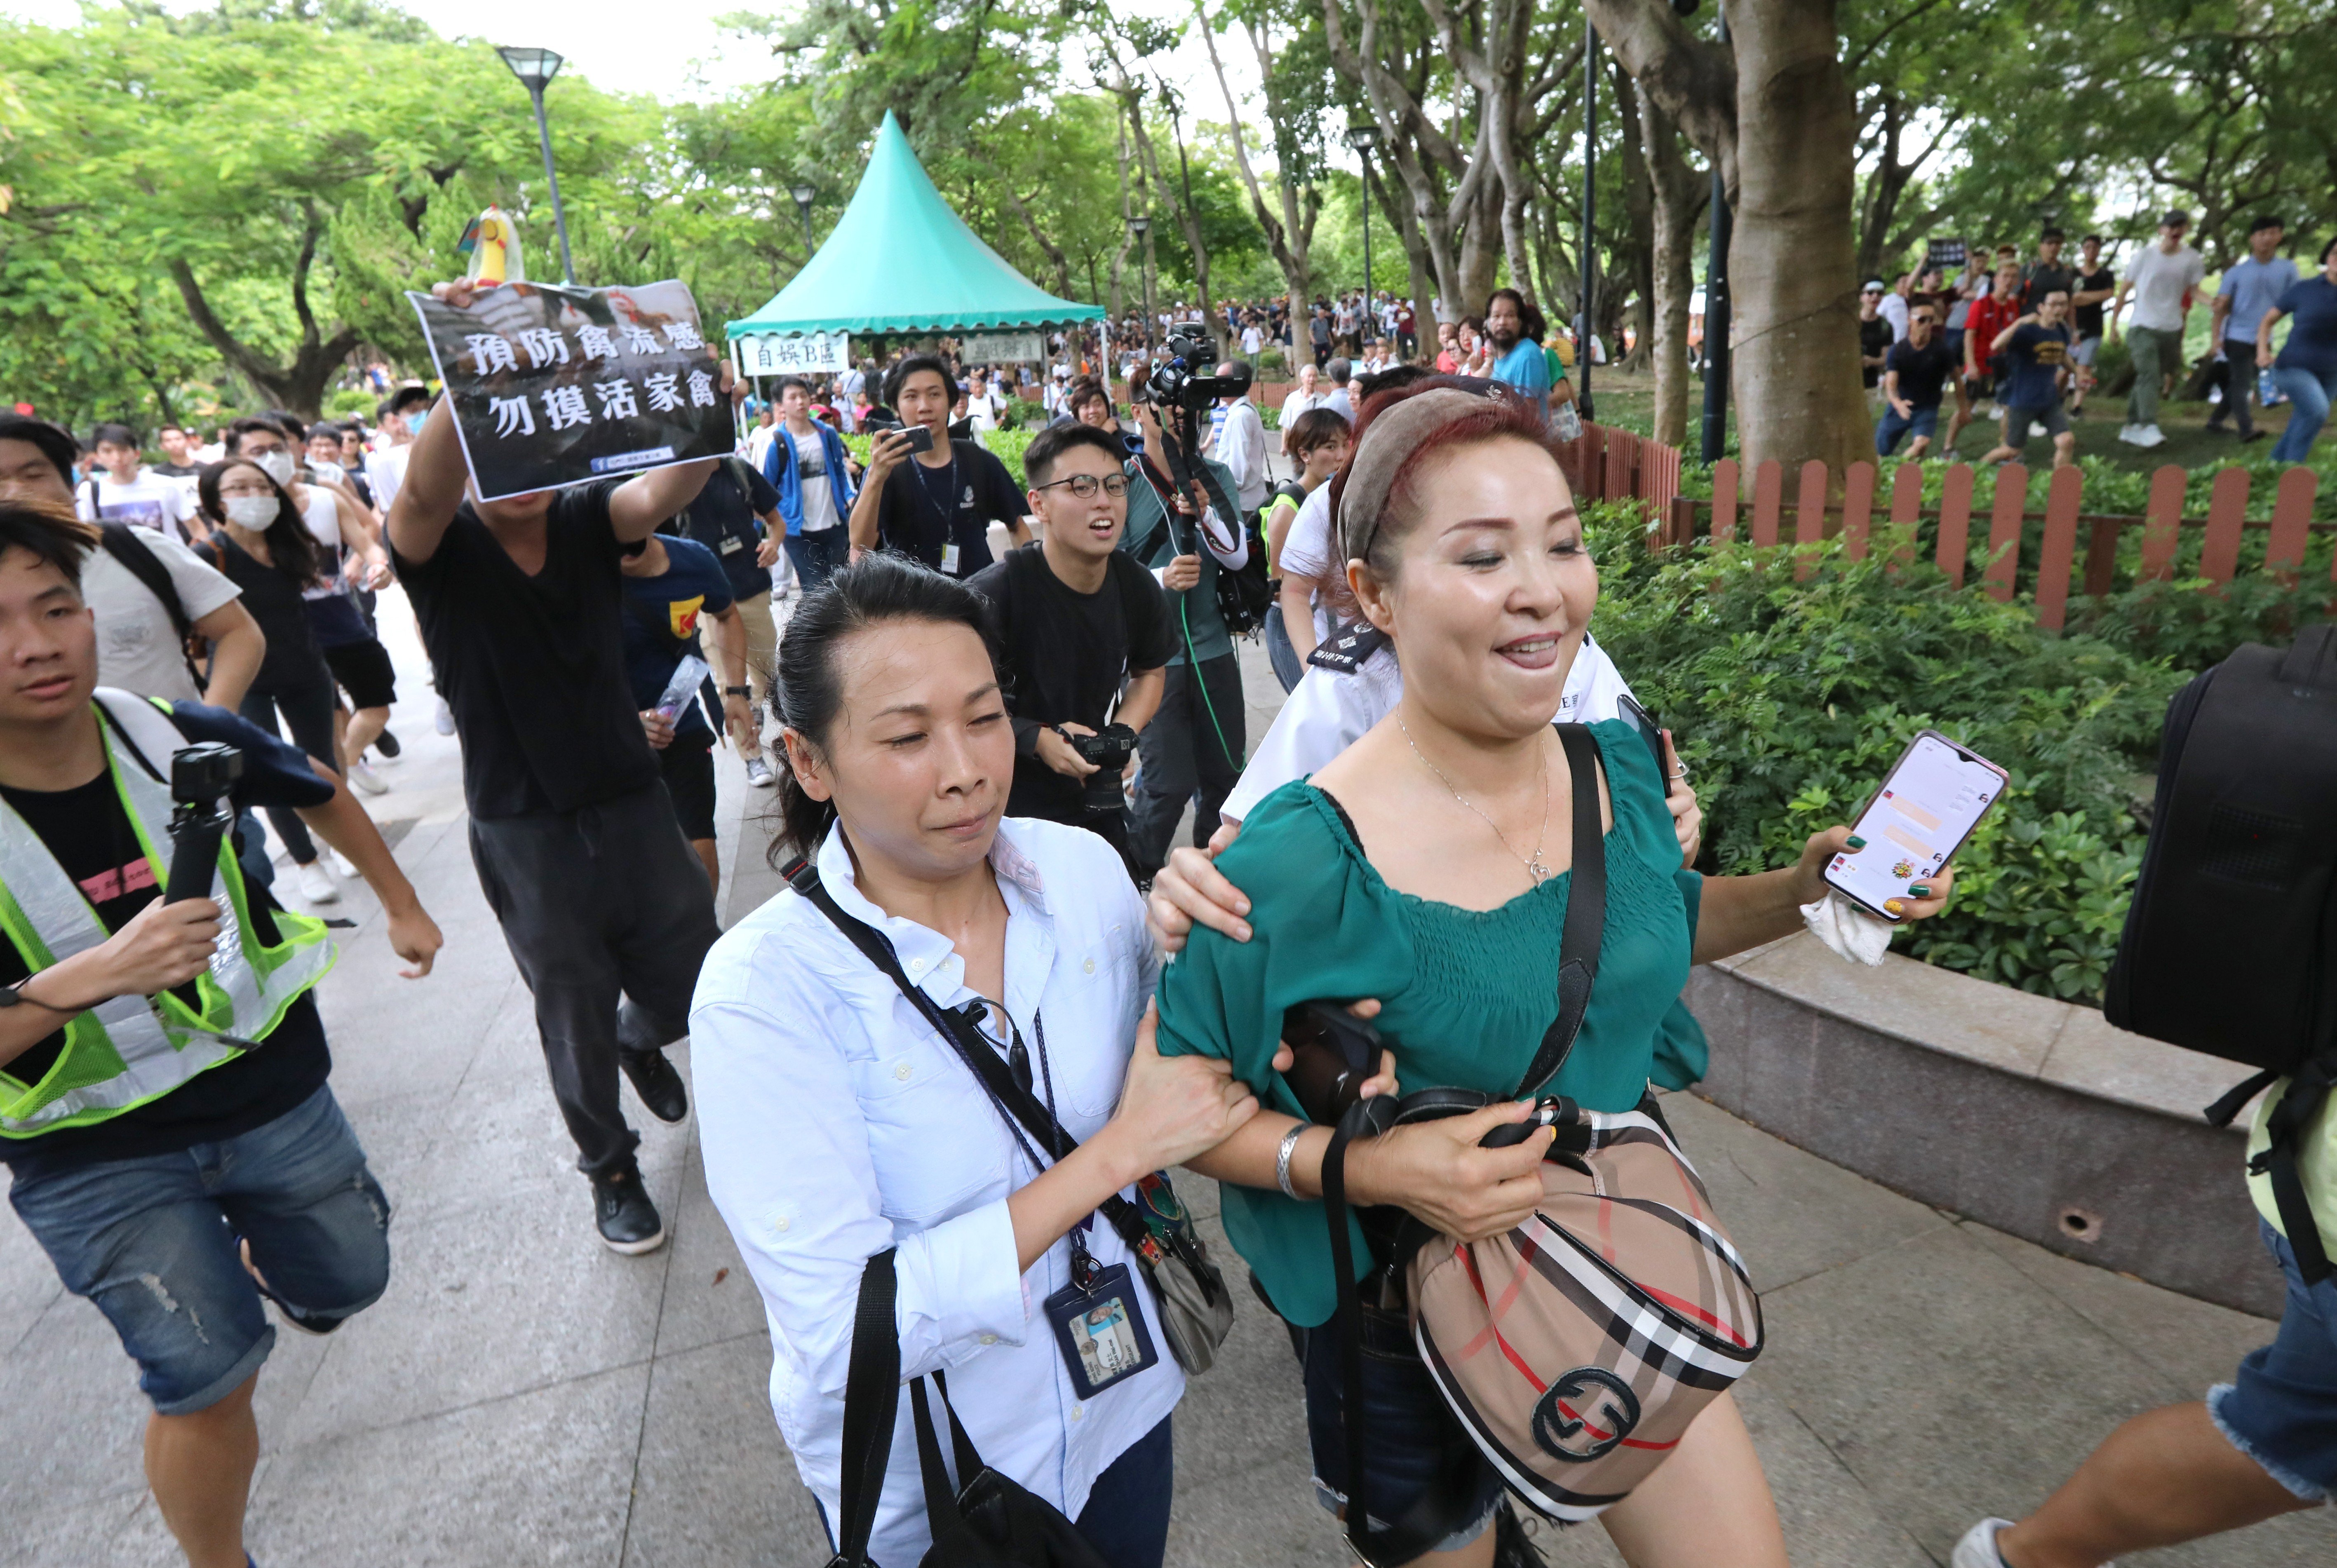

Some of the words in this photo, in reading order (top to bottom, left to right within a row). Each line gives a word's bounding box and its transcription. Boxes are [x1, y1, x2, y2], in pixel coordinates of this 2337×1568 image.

[464, 322, 706, 376] 預防禽流感
[758, 343, 836, 367] 自娛B區
[488, 369, 715, 439] 勿摸活家禽
